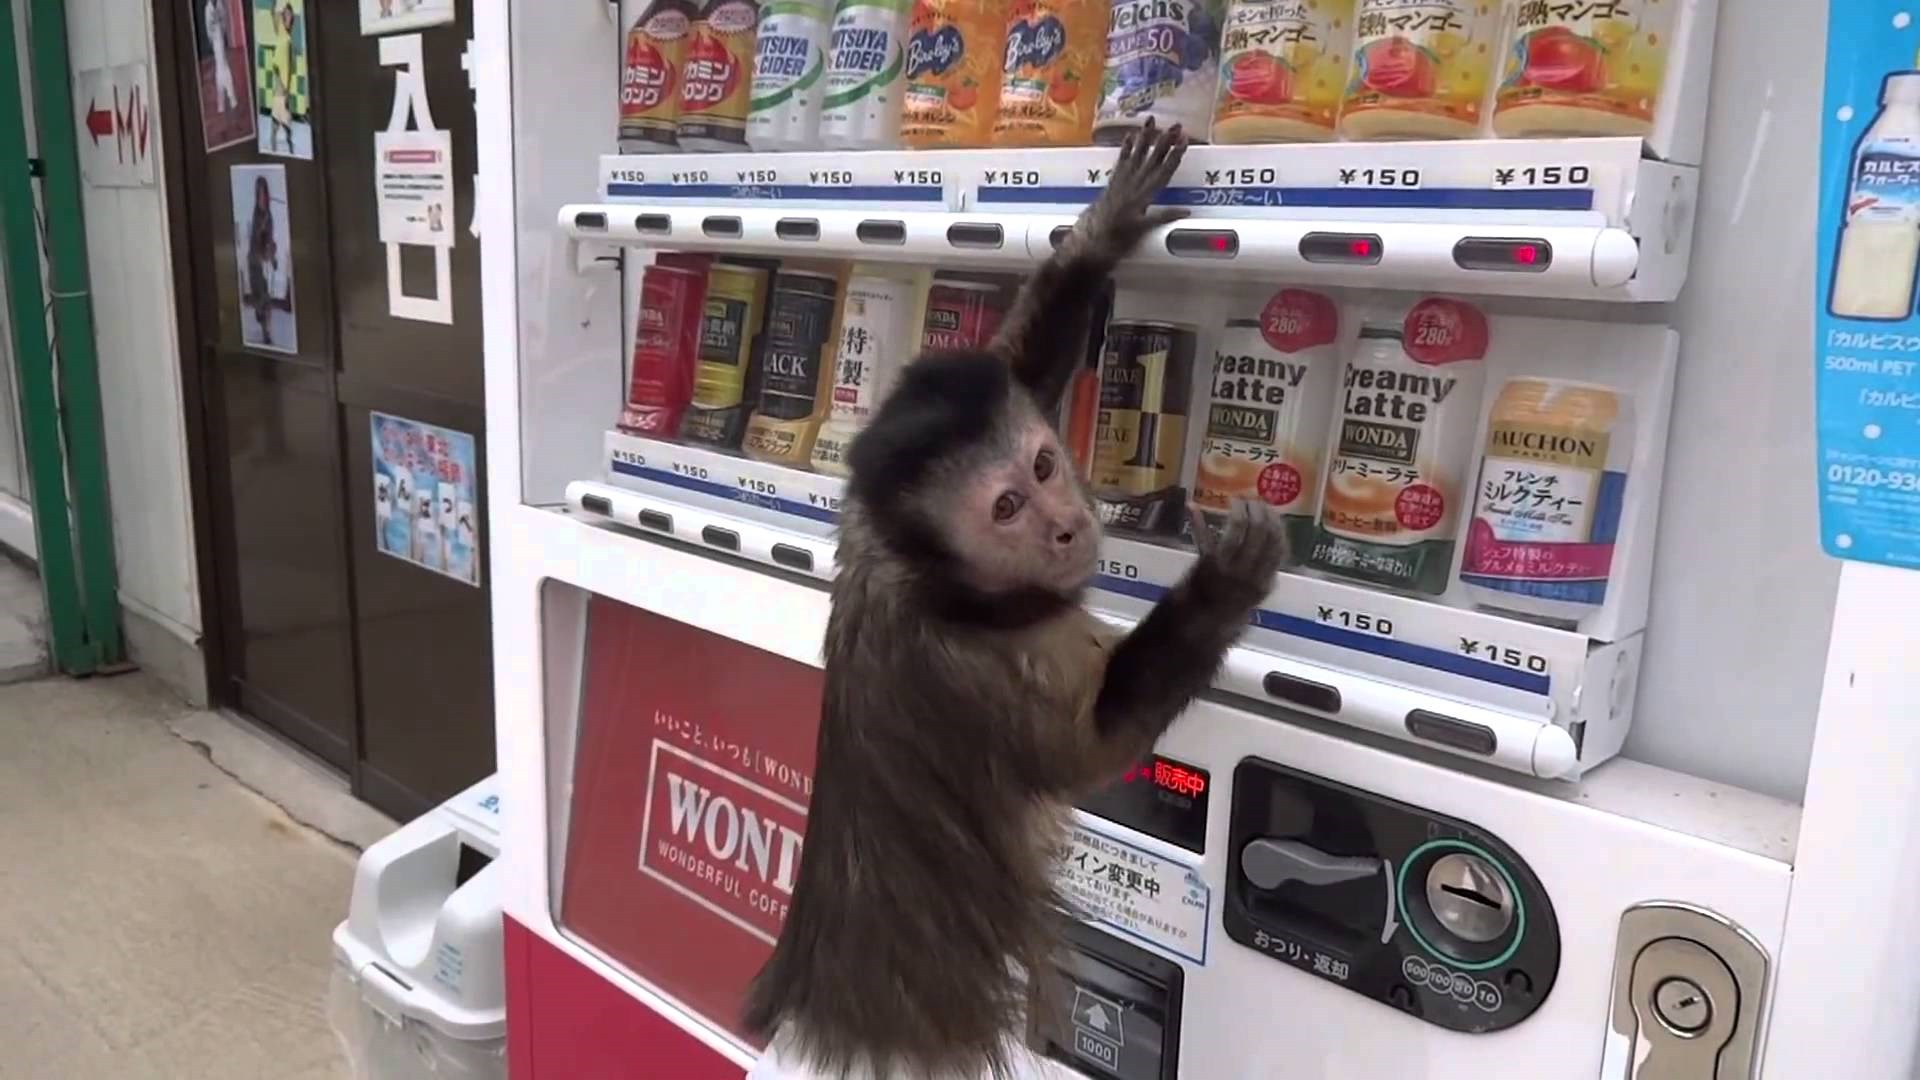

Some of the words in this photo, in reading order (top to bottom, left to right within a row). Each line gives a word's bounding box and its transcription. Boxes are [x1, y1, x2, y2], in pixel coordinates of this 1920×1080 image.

[1147, 28, 1174, 52] 50
[760, 56, 806, 76] CIDER
[834, 50, 885, 71] CIDER
[611, 170, 645, 183] ¥150
[672, 170, 708, 183] ¥150
[737, 170, 777, 183] ¥150
[809, 171, 852, 184] ¥150
[894, 170, 942, 185] ¥150
[984, 170, 1039, 185] ¥150
[1205, 168, 1276, 185] ¥150
[1339, 168, 1420, 187] ¥150
[1495, 166, 1590, 185] ¥150
[1881, 358, 1915, 376] PET
[1210, 376, 1285, 405] Latte
[1344, 388, 1427, 423] Latte
[613, 449, 645, 466] ¥150
[1202, 440, 1279, 463] リーミーラテ
[672, 461, 708, 480] ¥150
[1504, 470, 1558, 487] フレンチ
[737, 476, 776, 495] ¥150
[808, 493, 841, 511] ¥15
[1484, 481, 1583, 511] ミルクティー
[1097, 559, 1138, 580] 150
[1318, 606, 1393, 635] ¥150
[1460, 637, 1547, 673] ¥150
[1154, 761, 1205, 799] 販売中
[667, 771, 805, 896] WOND
[658, 838, 741, 898] WONDERFUL
[748, 888, 789, 922] COFF
[1060, 844, 1161, 898] ザイン変更中
[1253, 929, 1350, 982] おつり・返却
[1404, 961, 1428, 977] 500
[1430, 969, 1450, 987] 100
[1453, 980, 1473, 996] 50
[1478, 990, 1496, 1003] 10
[1082, 1036, 1112, 1062] 1000
